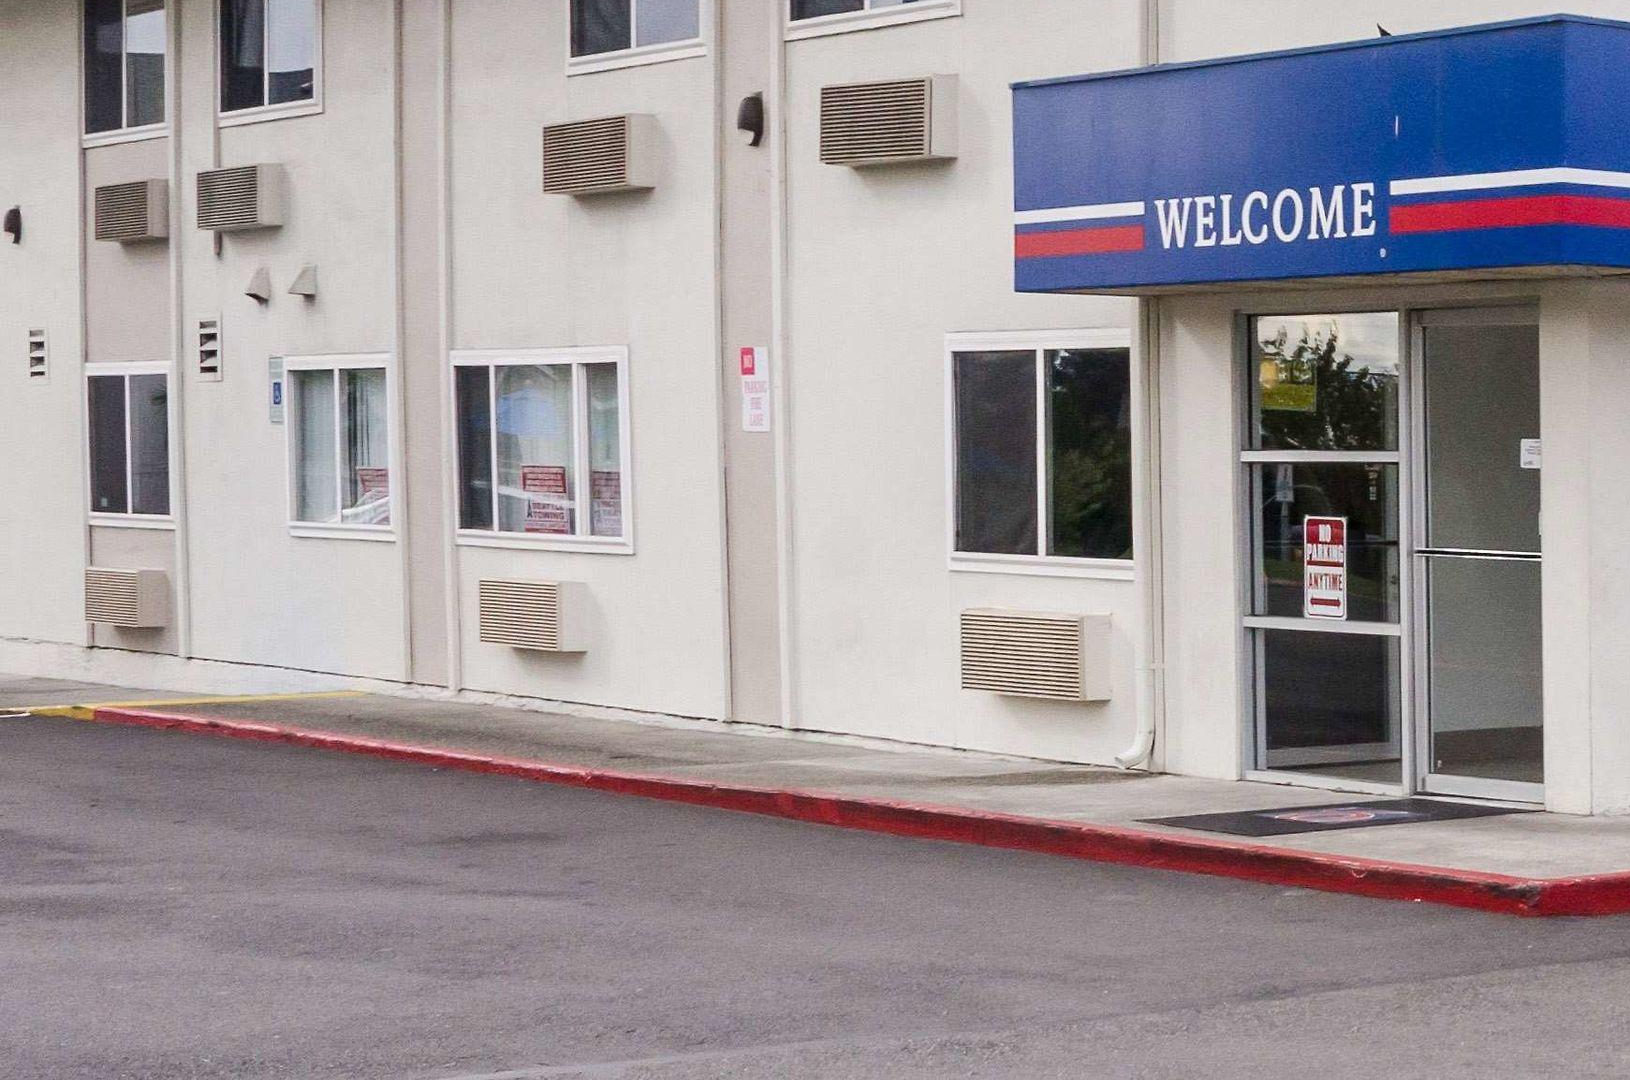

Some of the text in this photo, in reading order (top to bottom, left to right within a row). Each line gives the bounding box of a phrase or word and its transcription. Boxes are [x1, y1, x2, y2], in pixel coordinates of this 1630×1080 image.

[1154, 182, 1377, 250] WELCOME
[1318, 524, 1331, 542] NO
[1307, 544, 1344, 561] PARKING
[1308, 572, 1342, 591] ANYTIME
